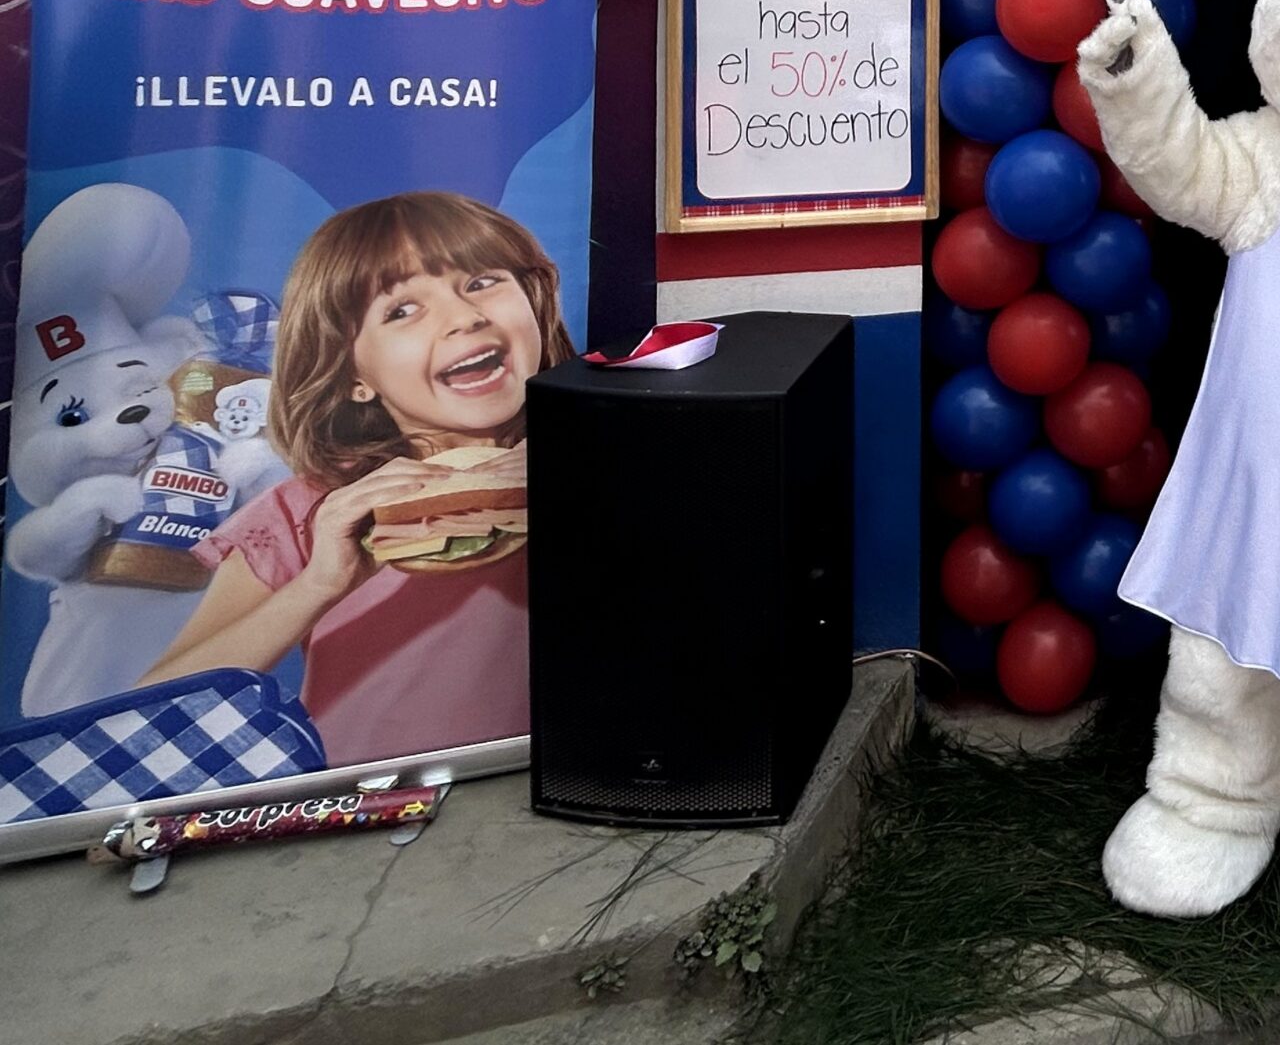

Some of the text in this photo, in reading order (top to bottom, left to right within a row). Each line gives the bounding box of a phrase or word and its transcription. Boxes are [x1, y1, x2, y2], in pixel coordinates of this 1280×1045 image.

[758, 1, 850, 41] hasta
[718, 42, 899, 98] el 50% de
[135, 76, 498, 108] ¡LLEVALO A CASA!
[704, 100, 908, 157] Descuento
[36, 314, 86, 361] B
[151, 470, 229, 498] BIMBO
[137, 515, 211, 540] Blanco
